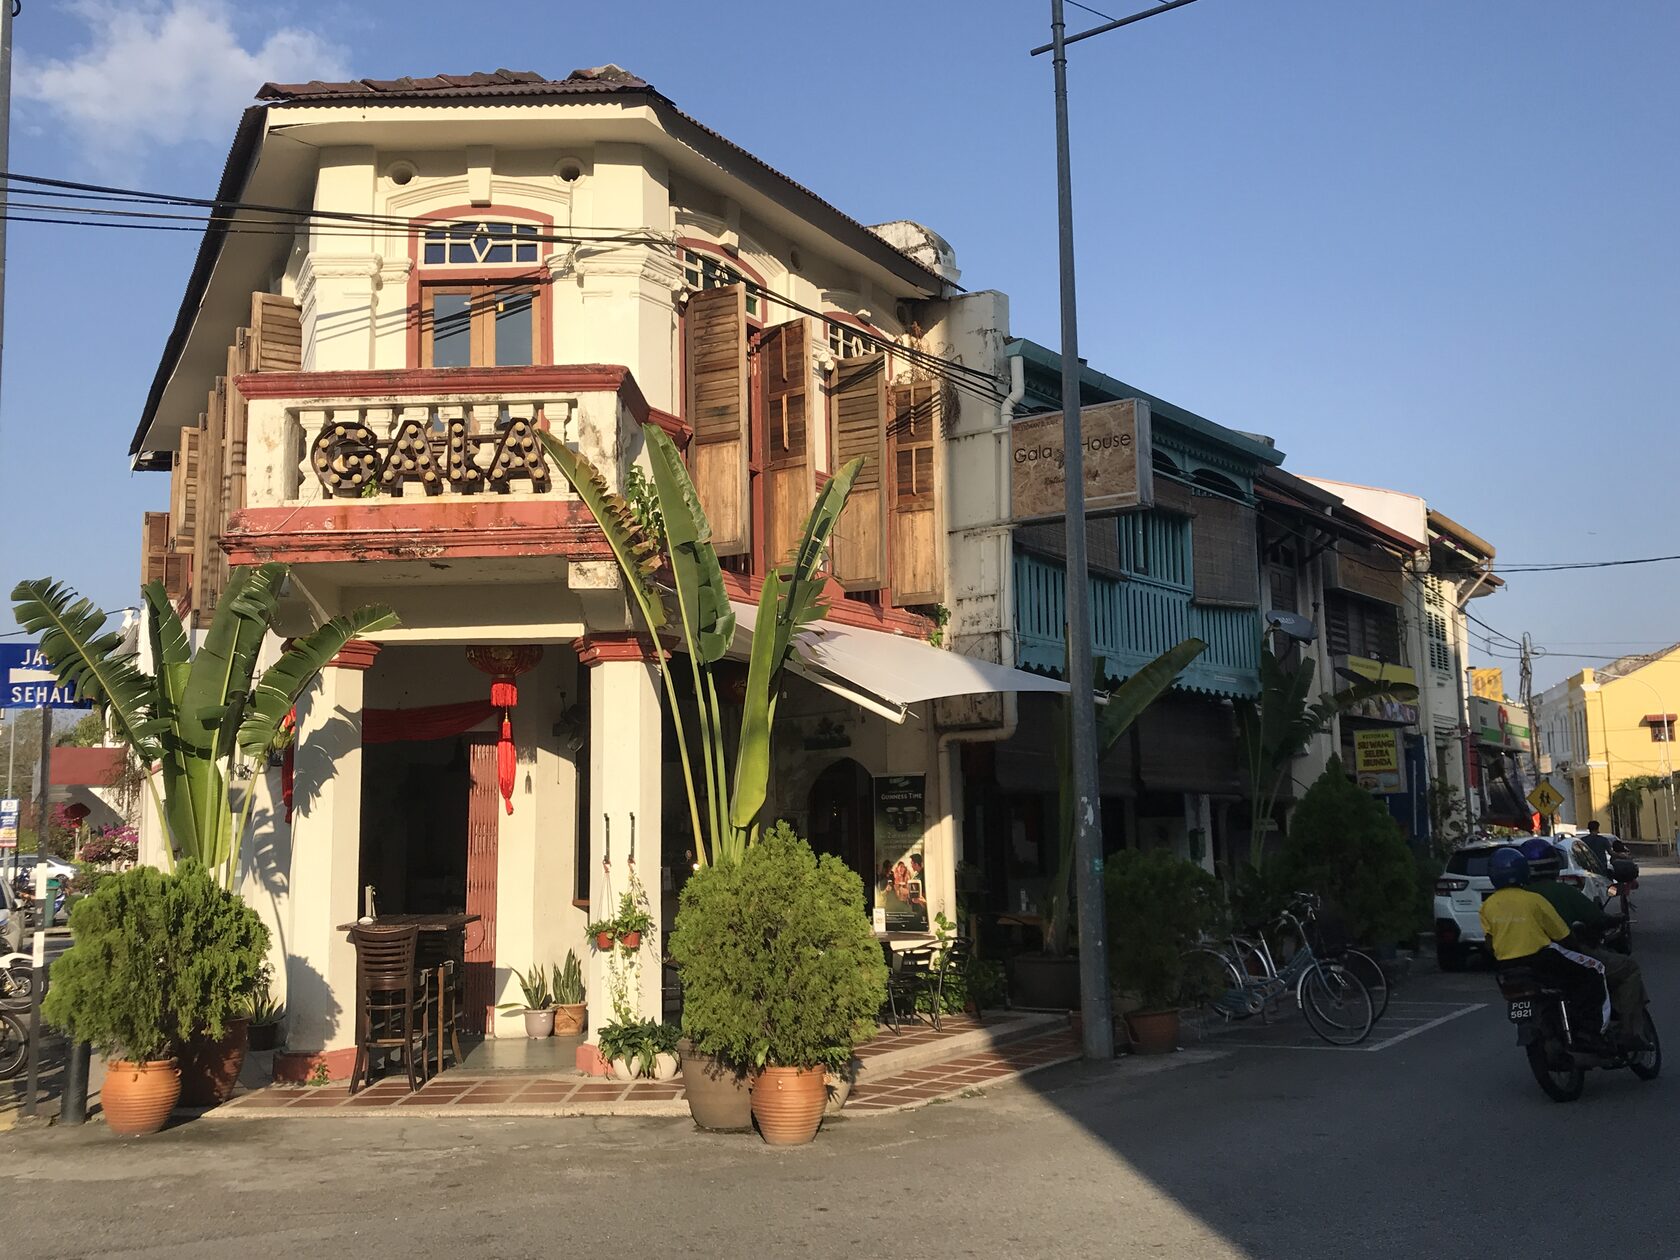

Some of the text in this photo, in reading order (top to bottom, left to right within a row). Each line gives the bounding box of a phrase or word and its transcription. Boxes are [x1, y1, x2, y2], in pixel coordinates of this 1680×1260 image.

[311, 418, 550, 489] GALA
[1014, 445, 1053, 463] Gala
[1512, 1001, 1530, 1009] PCU
[1511, 1009, 1531, 1018] 5821
